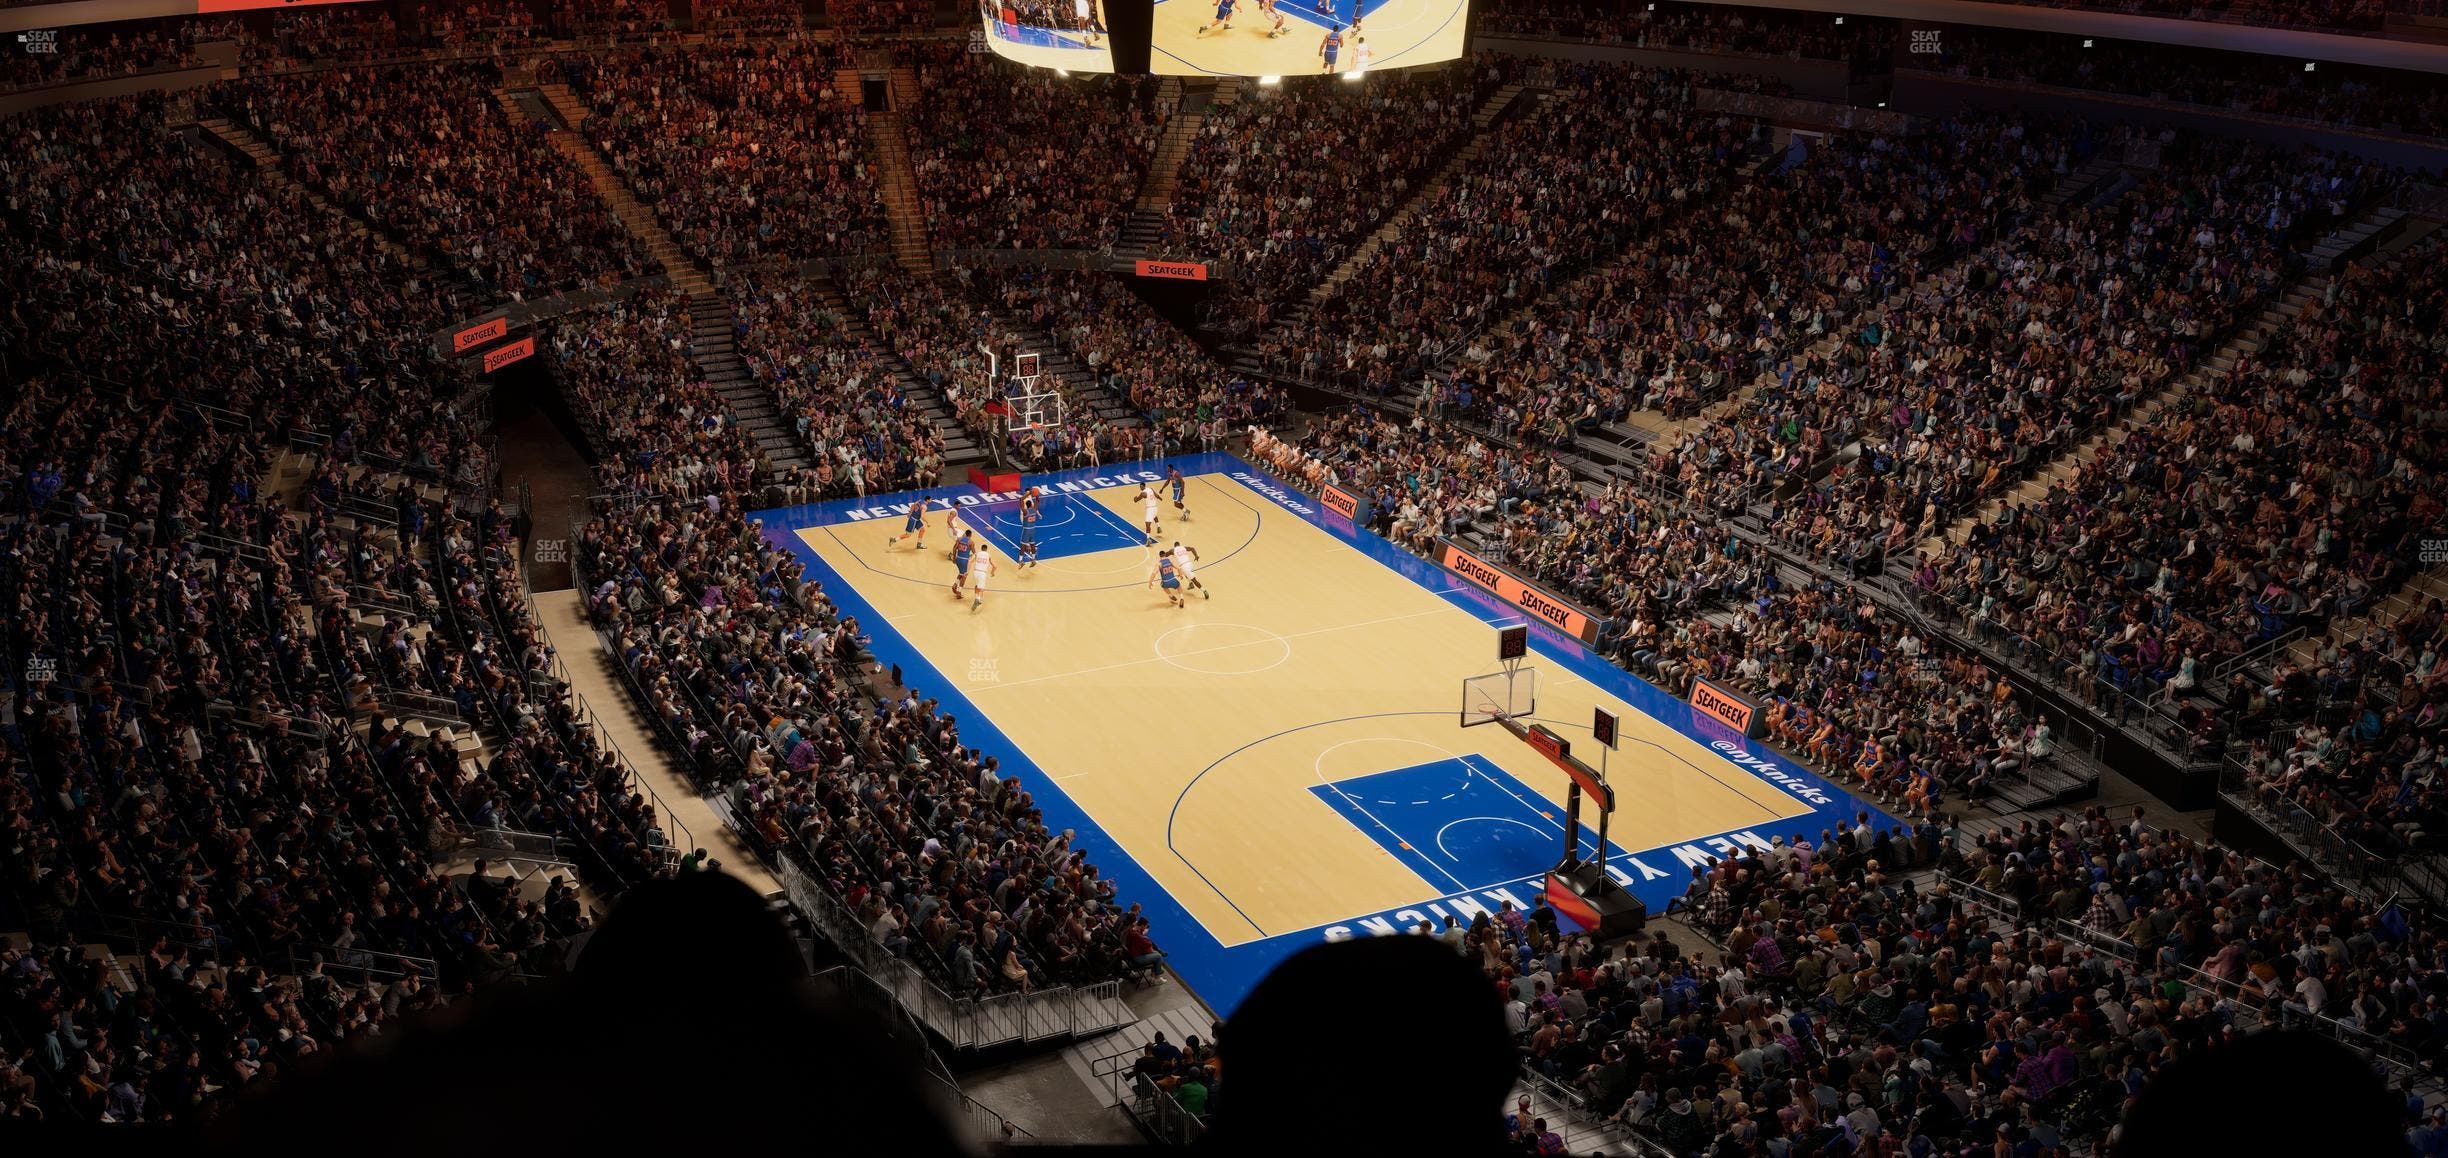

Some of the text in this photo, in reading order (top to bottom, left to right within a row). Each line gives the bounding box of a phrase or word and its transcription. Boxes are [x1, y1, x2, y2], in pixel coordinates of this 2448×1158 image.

[1148, 264, 1195, 277] SEATGEEK
[462, 325, 497, 346] SEATGEEK
[492, 345, 525, 367] SEATGEEK
[1032, 471, 1162, 496] KNICKS
[1231, 472, 1315, 515] nyknicks.com
[1323, 488, 1355, 516] SEATGEEK
[1454, 555, 1501, 591] SEATGEEK
[1519, 590, 1570, 629] SEATGEEK
[1695, 688, 1747, 728] SEATGEEK
[1532, 731, 1557, 753] SEATGEEK
[1711, 740, 1833, 804] @nyknicks
